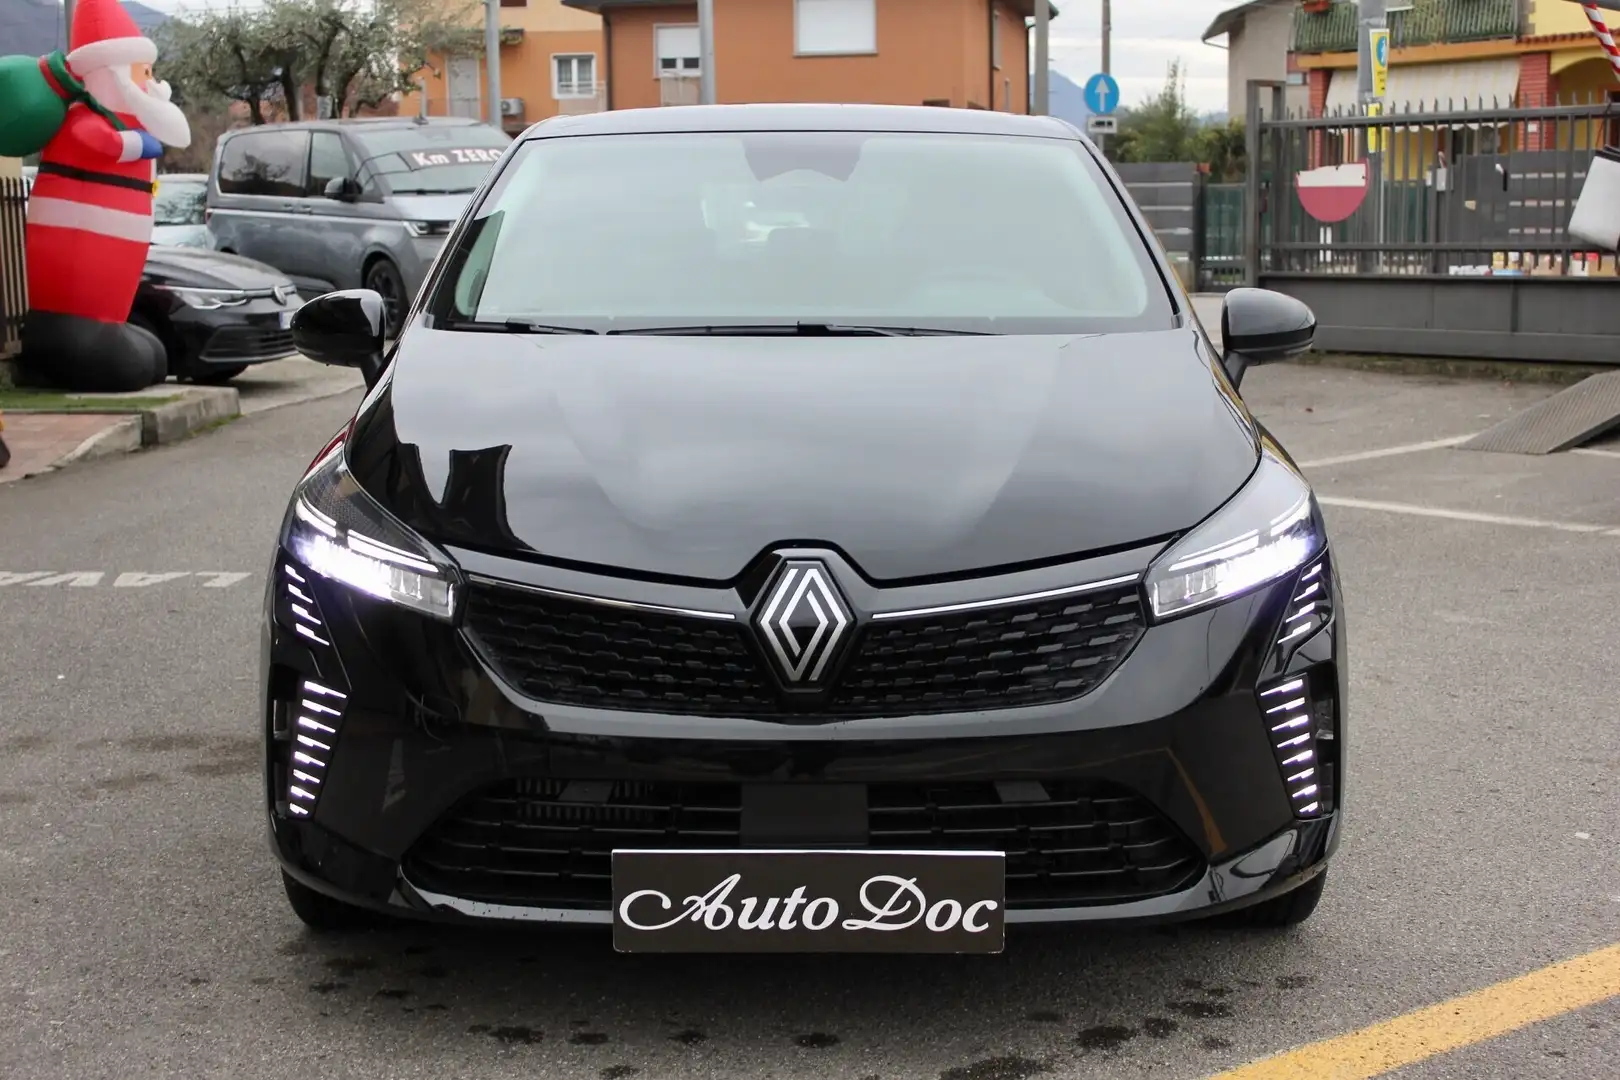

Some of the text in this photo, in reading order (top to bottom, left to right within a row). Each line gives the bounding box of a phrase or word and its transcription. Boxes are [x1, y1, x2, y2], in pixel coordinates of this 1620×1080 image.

[412, 152, 450, 166] Km
[619, 873, 998, 933] Auto Doc
